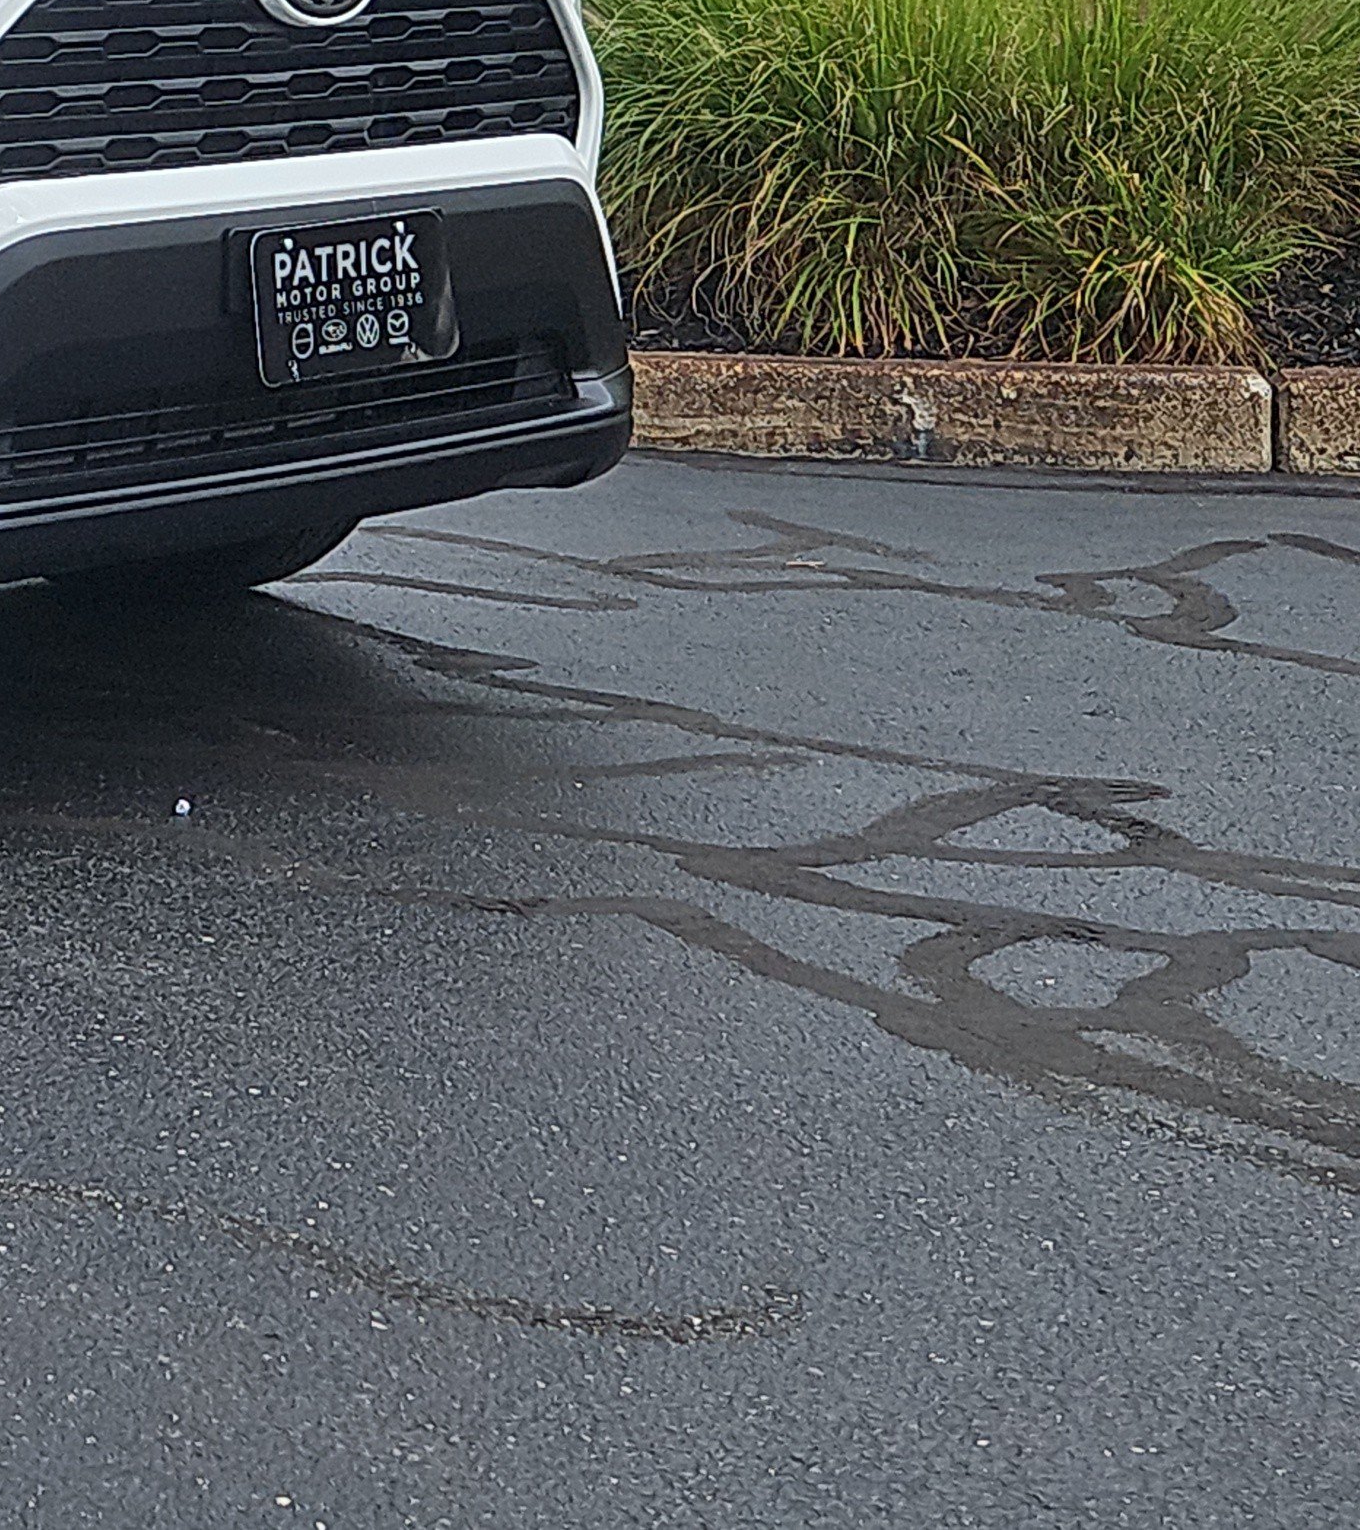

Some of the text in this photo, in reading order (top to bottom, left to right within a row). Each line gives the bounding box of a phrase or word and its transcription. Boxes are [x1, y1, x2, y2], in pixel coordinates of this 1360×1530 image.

[274, 234, 419, 289] PATRICK
[276, 272, 421, 308] MOTOR GROUP
[278, 291, 424, 325] TRUSTED SINCE 1936
